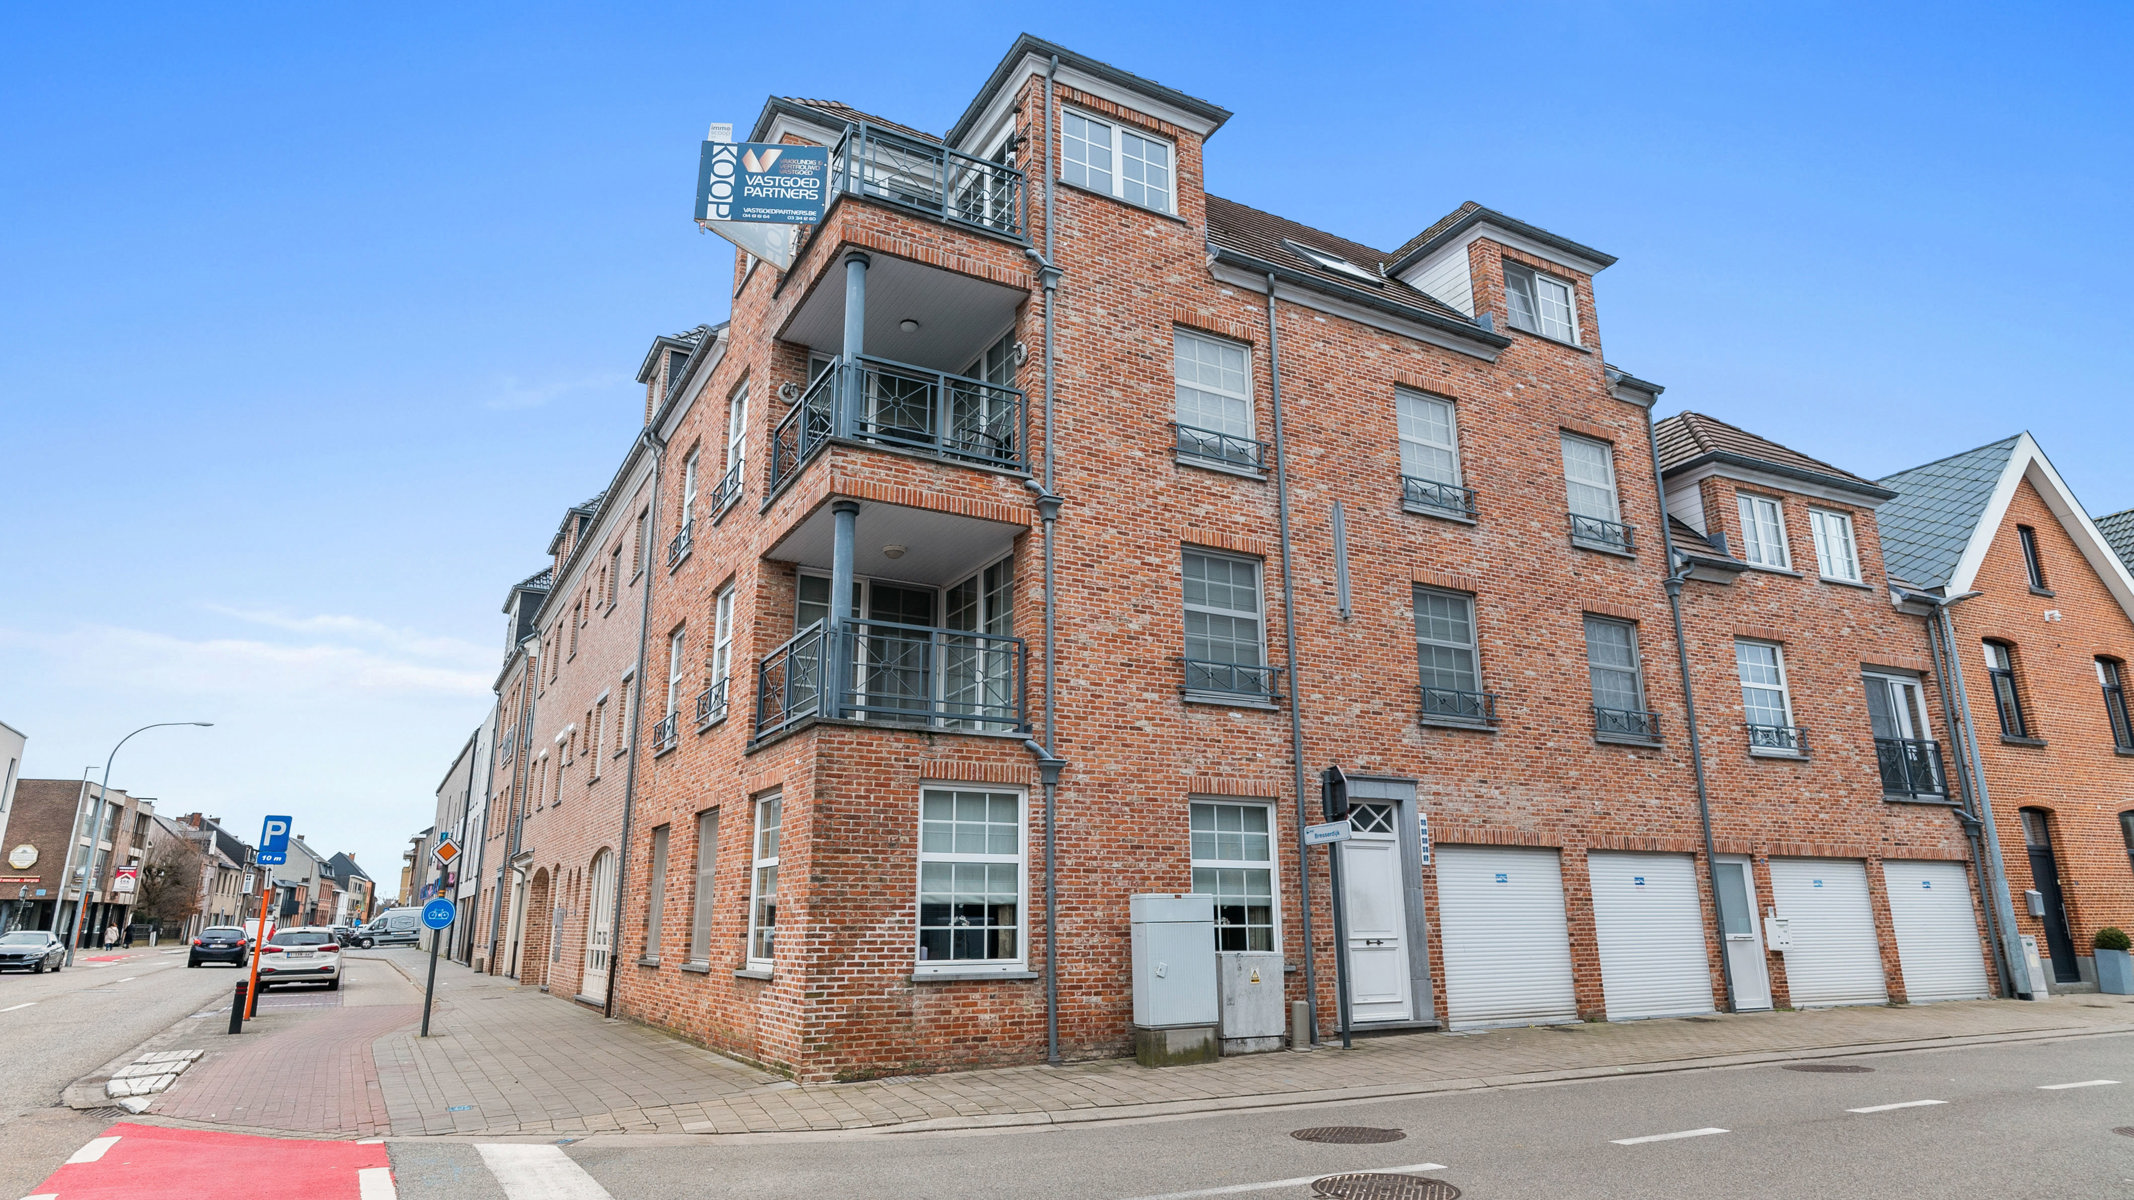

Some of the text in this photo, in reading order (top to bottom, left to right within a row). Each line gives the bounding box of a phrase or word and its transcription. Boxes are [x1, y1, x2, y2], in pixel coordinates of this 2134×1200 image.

[708, 143, 738, 218] KOOP
[745, 175, 820, 188] VASTGOED
[744, 186, 819, 200] PARTNERS
[263, 820, 287, 846] P
